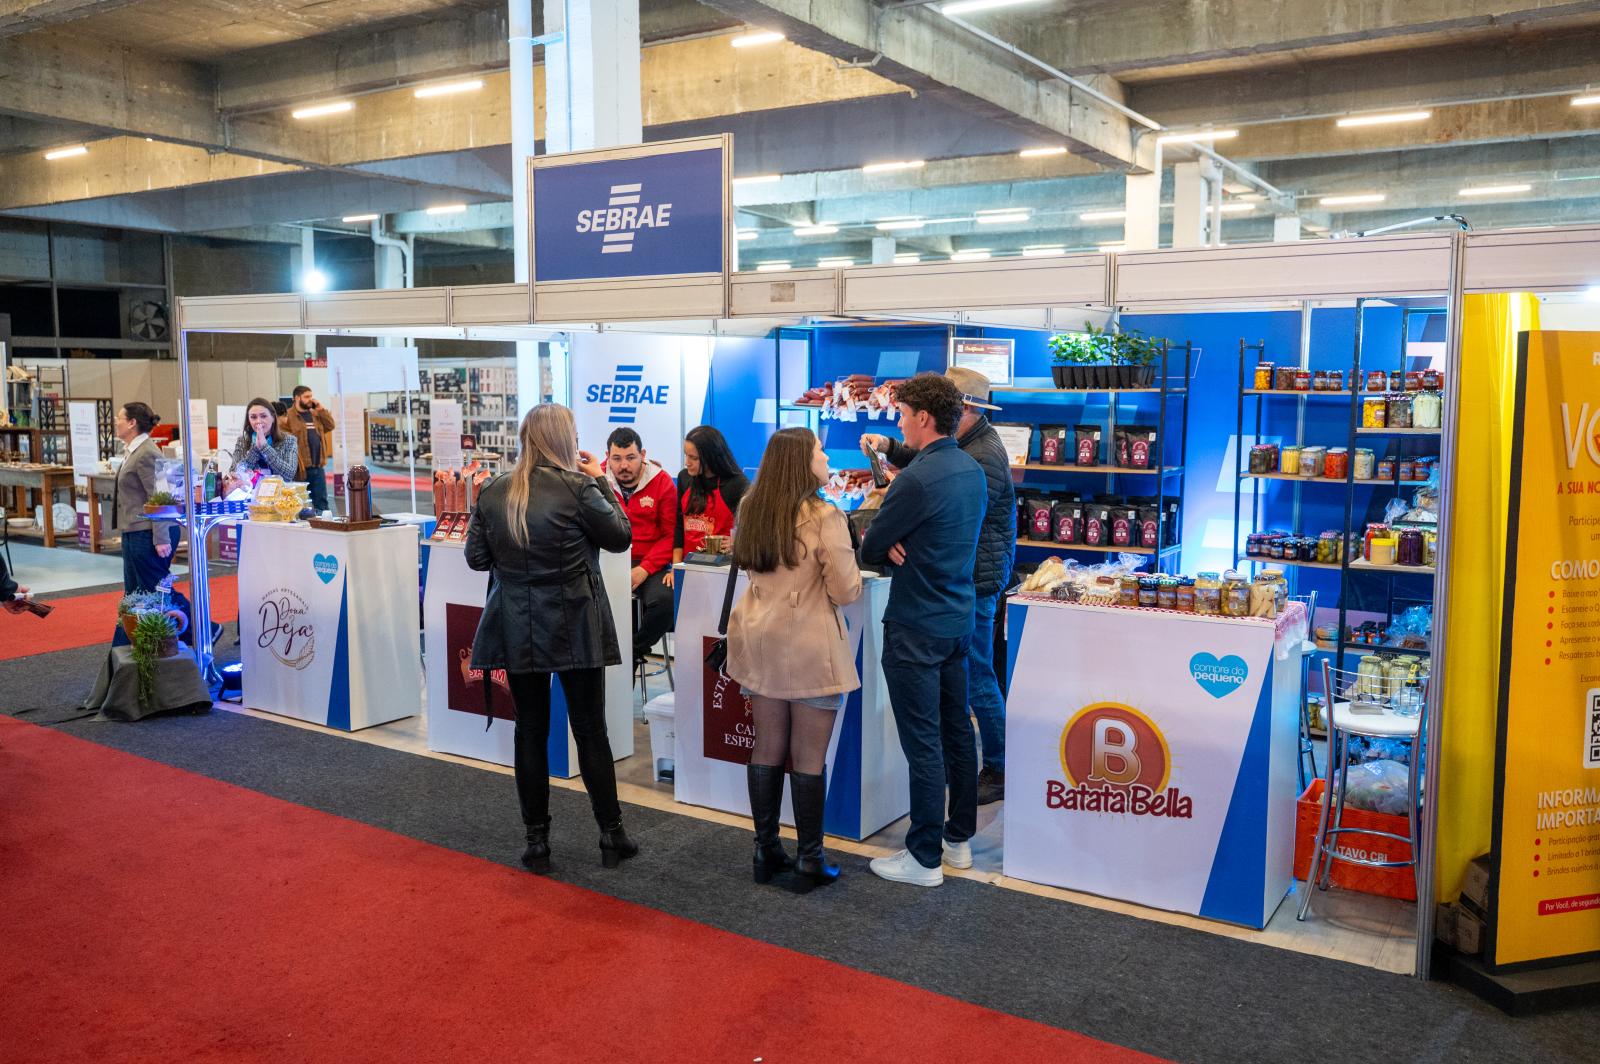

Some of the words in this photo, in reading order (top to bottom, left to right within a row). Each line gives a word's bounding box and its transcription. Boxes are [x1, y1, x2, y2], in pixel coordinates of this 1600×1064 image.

[576, 203, 673, 233] SEBRAE
[586, 384, 669, 405] SEBRAE
[1557, 482, 1563, 495] A
[1567, 481, 1584, 495] SUA
[1551, 559, 1600, 581] COMO
[278, 596, 306, 621] Dona
[1193, 662, 1229, 675] compre
[1231, 666, 1244, 676] do
[1193, 670, 1244, 685] pequeno
[1046, 780, 1126, 814] Batata
[1129, 785, 1192, 819] Bella
[1545, 903, 1555, 914] Por
[1571, 899, 1579, 909] de
